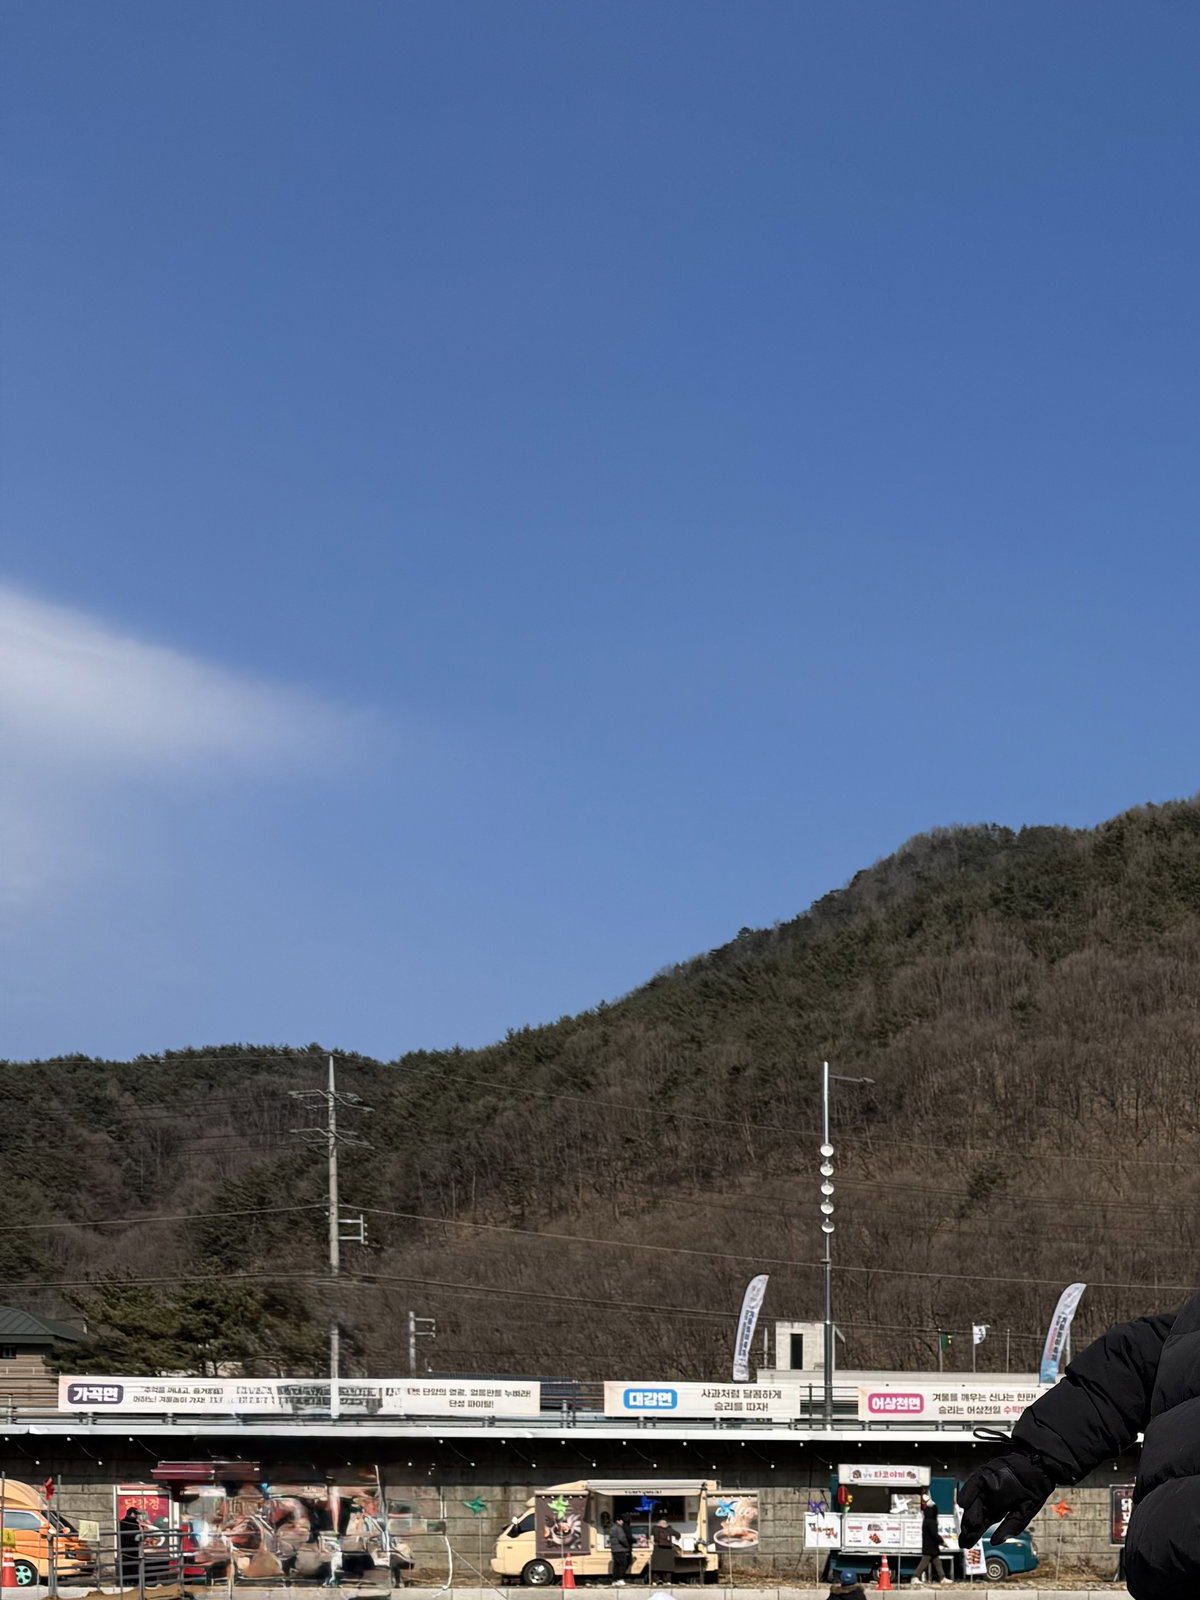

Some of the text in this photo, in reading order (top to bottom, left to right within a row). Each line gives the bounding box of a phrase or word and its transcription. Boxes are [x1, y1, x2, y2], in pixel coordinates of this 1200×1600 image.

[74, 1386, 118, 1402] 가곡면
[629, 1391, 673, 1407] 대강면
[701, 1389, 782, 1400] 사과처럼 달콤하게
[961, 1393, 987, 1402] 깨우는
[989, 1393, 1014, 1402] 신나는
[714, 1402, 769, 1412] 승리를 따자!
[872, 1396, 921, 1411] 어상천면
[938, 1405, 964, 1415] 승리는
